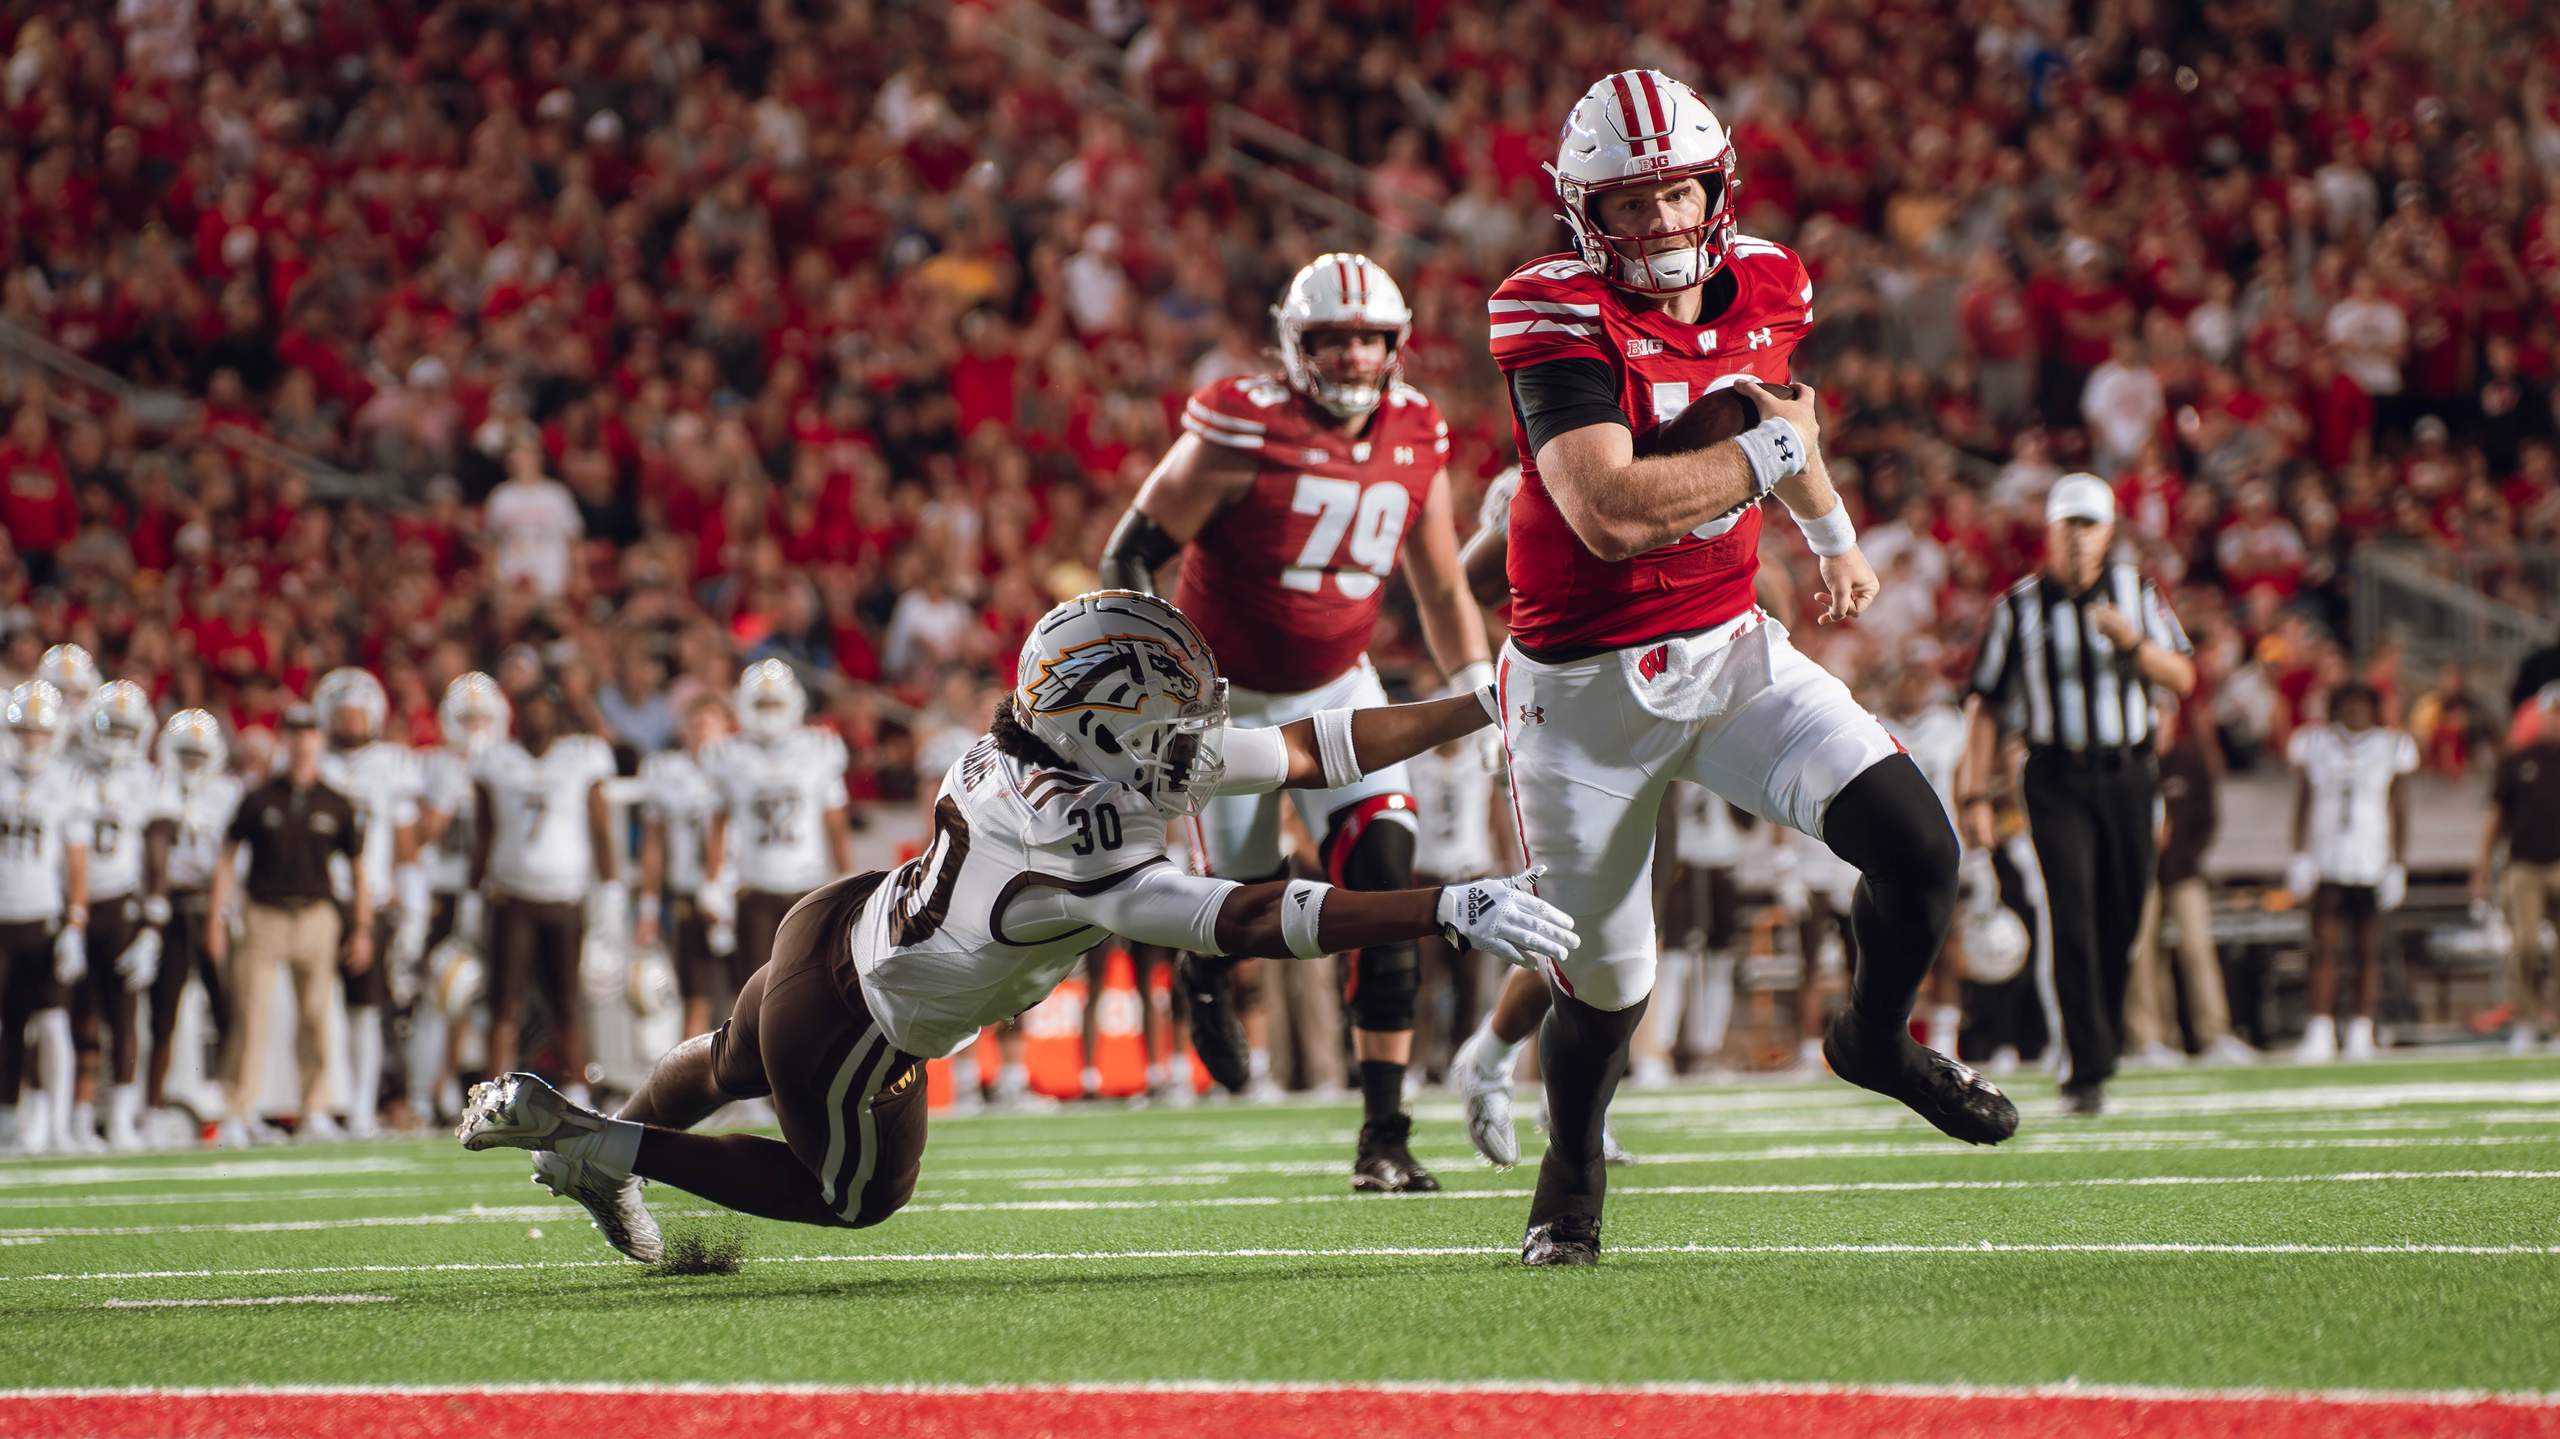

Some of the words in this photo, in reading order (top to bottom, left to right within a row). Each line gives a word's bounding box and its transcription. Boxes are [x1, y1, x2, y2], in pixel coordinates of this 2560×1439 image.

[1281, 474, 1410, 600] 79
[1067, 802, 1124, 856] 30
[1468, 887, 1478, 926] adidas
